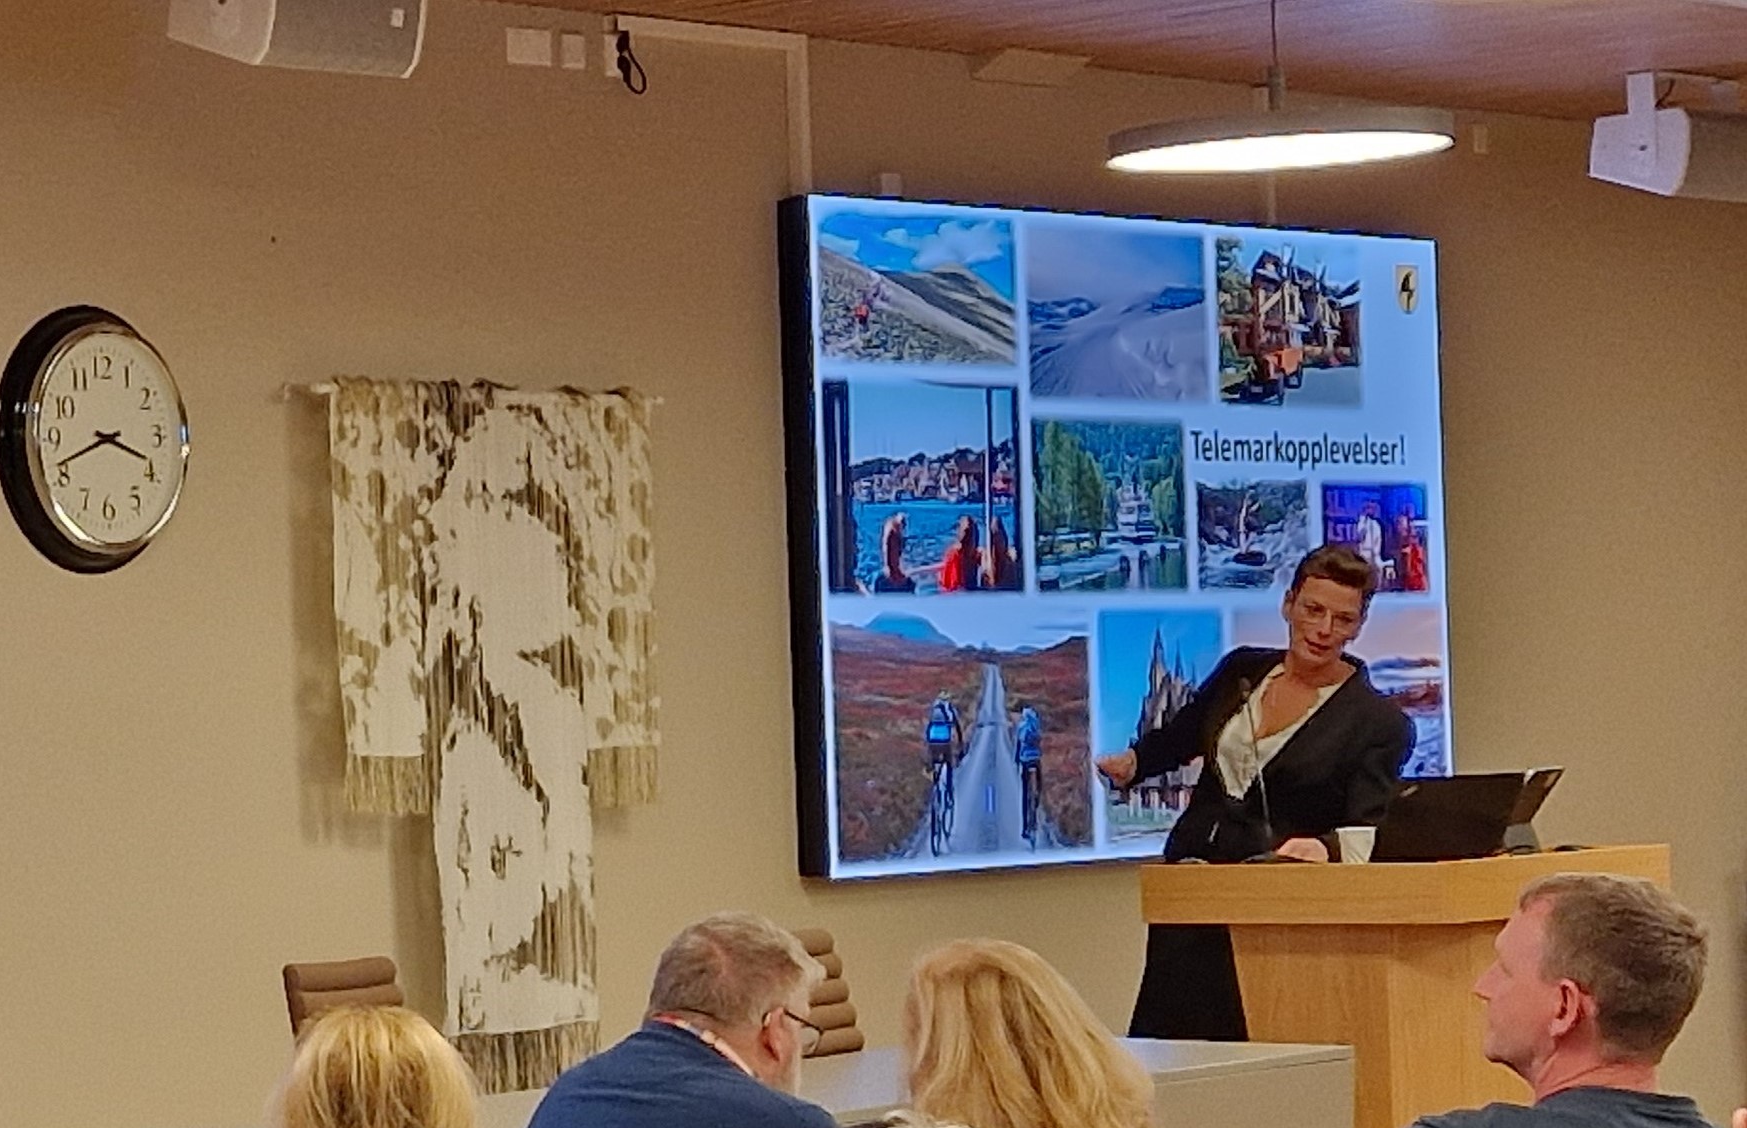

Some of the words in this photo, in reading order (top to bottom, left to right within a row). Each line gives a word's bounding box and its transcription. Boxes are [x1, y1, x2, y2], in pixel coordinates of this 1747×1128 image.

[72, 367, 88, 391] 11
[92, 355, 112, 380] 12
[123, 364, 131, 389] 1
[55, 396, 76, 420] 10
[139, 387, 152, 411] 2
[47, 426, 61, 451] 9
[151, 424, 163, 449] 3
[1190, 429, 1406, 471] Telemarkopplevelser!
[57, 463, 71, 489] 8
[143, 457, 155, 483] 4
[79, 488, 91, 512] 7
[102, 495, 117, 521] 6
[130, 485, 142, 512] 5
